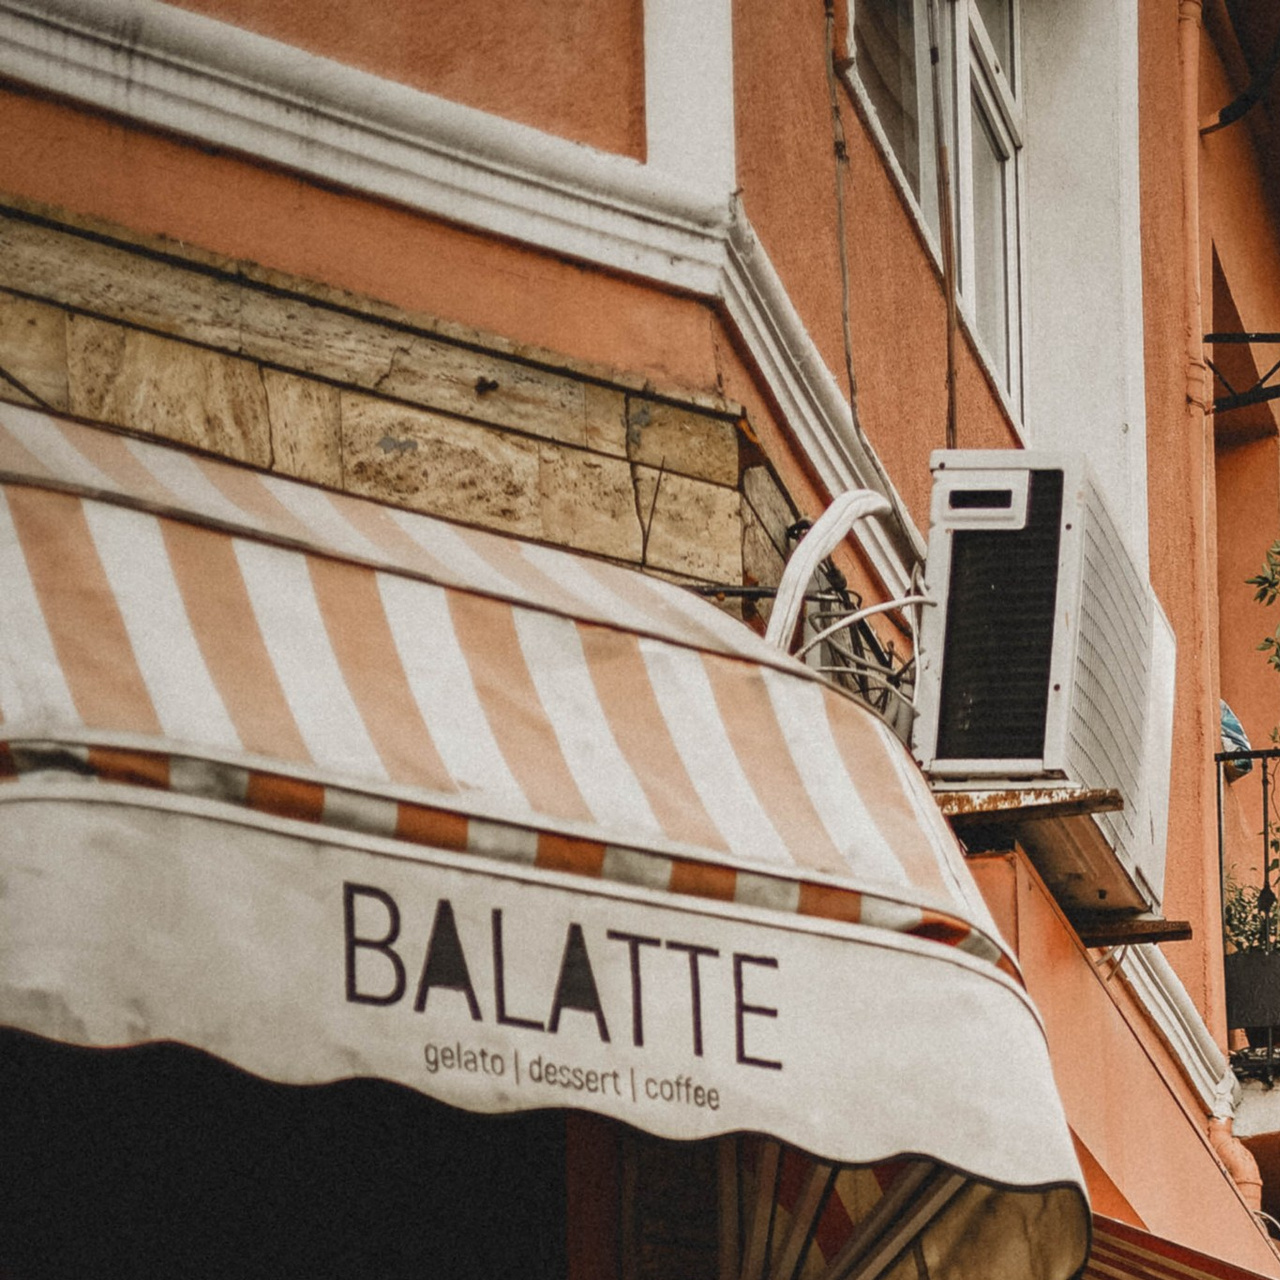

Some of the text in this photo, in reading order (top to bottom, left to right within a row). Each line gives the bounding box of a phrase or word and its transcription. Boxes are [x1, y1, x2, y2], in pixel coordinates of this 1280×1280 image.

[343, 881, 782, 1070] BALATTE
[424, 1042, 720, 1110] gelato dessert coffee
